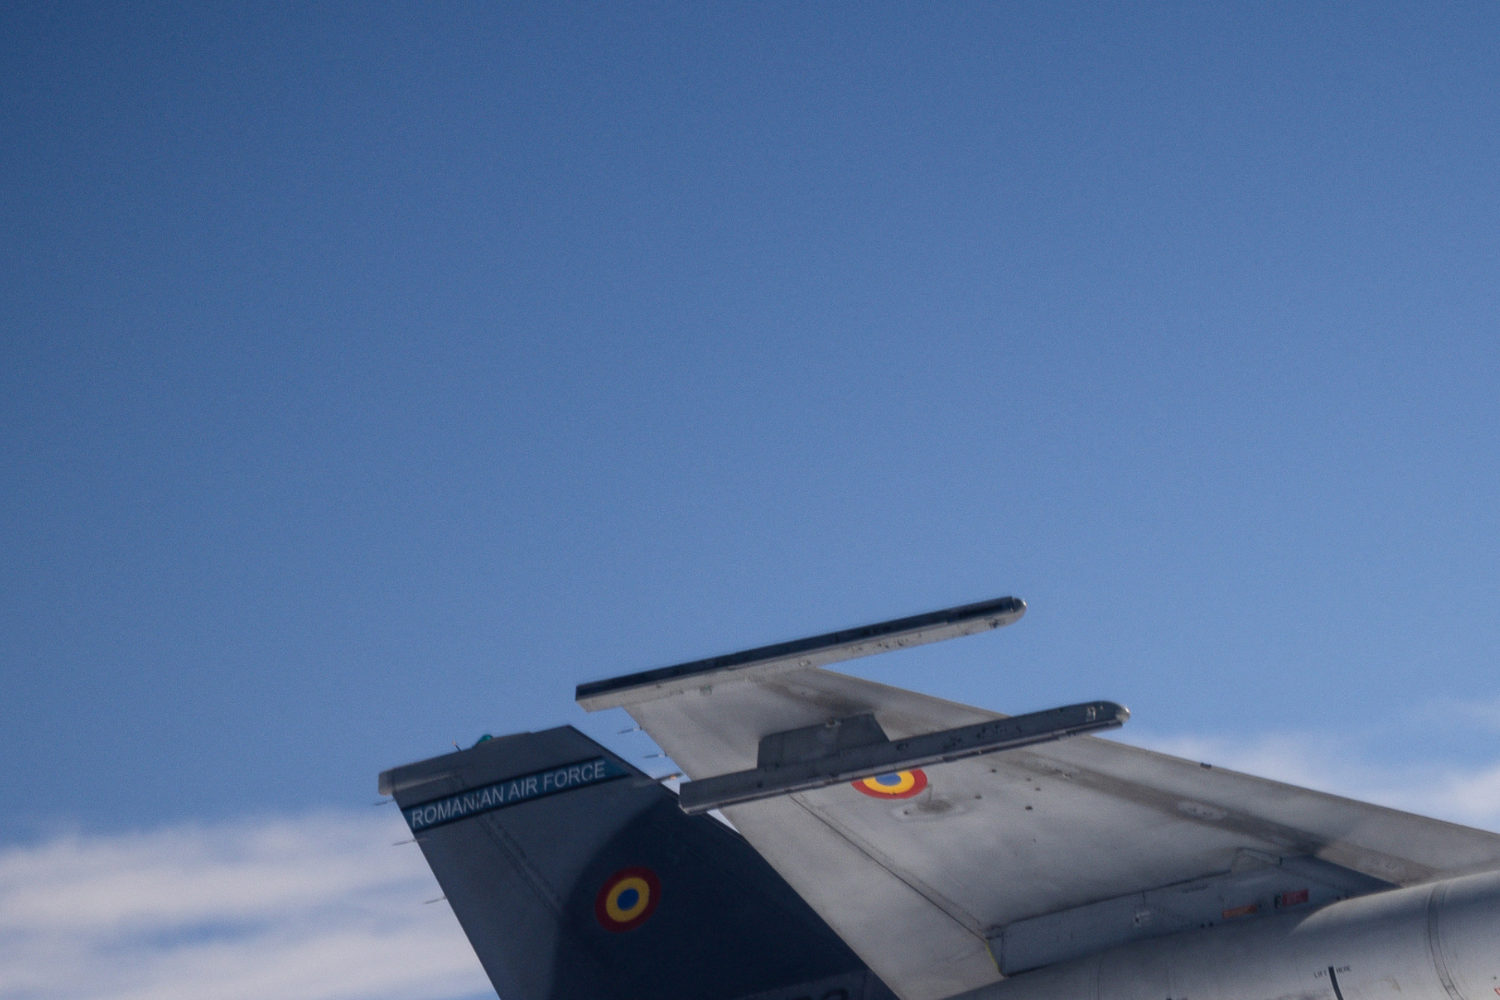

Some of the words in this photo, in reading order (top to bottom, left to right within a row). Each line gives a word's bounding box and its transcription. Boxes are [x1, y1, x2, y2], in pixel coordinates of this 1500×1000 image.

[412, 785, 504, 828] ROMANIAN
[508, 778, 538, 800] AIR
[543, 761, 606, 791] FORCE
